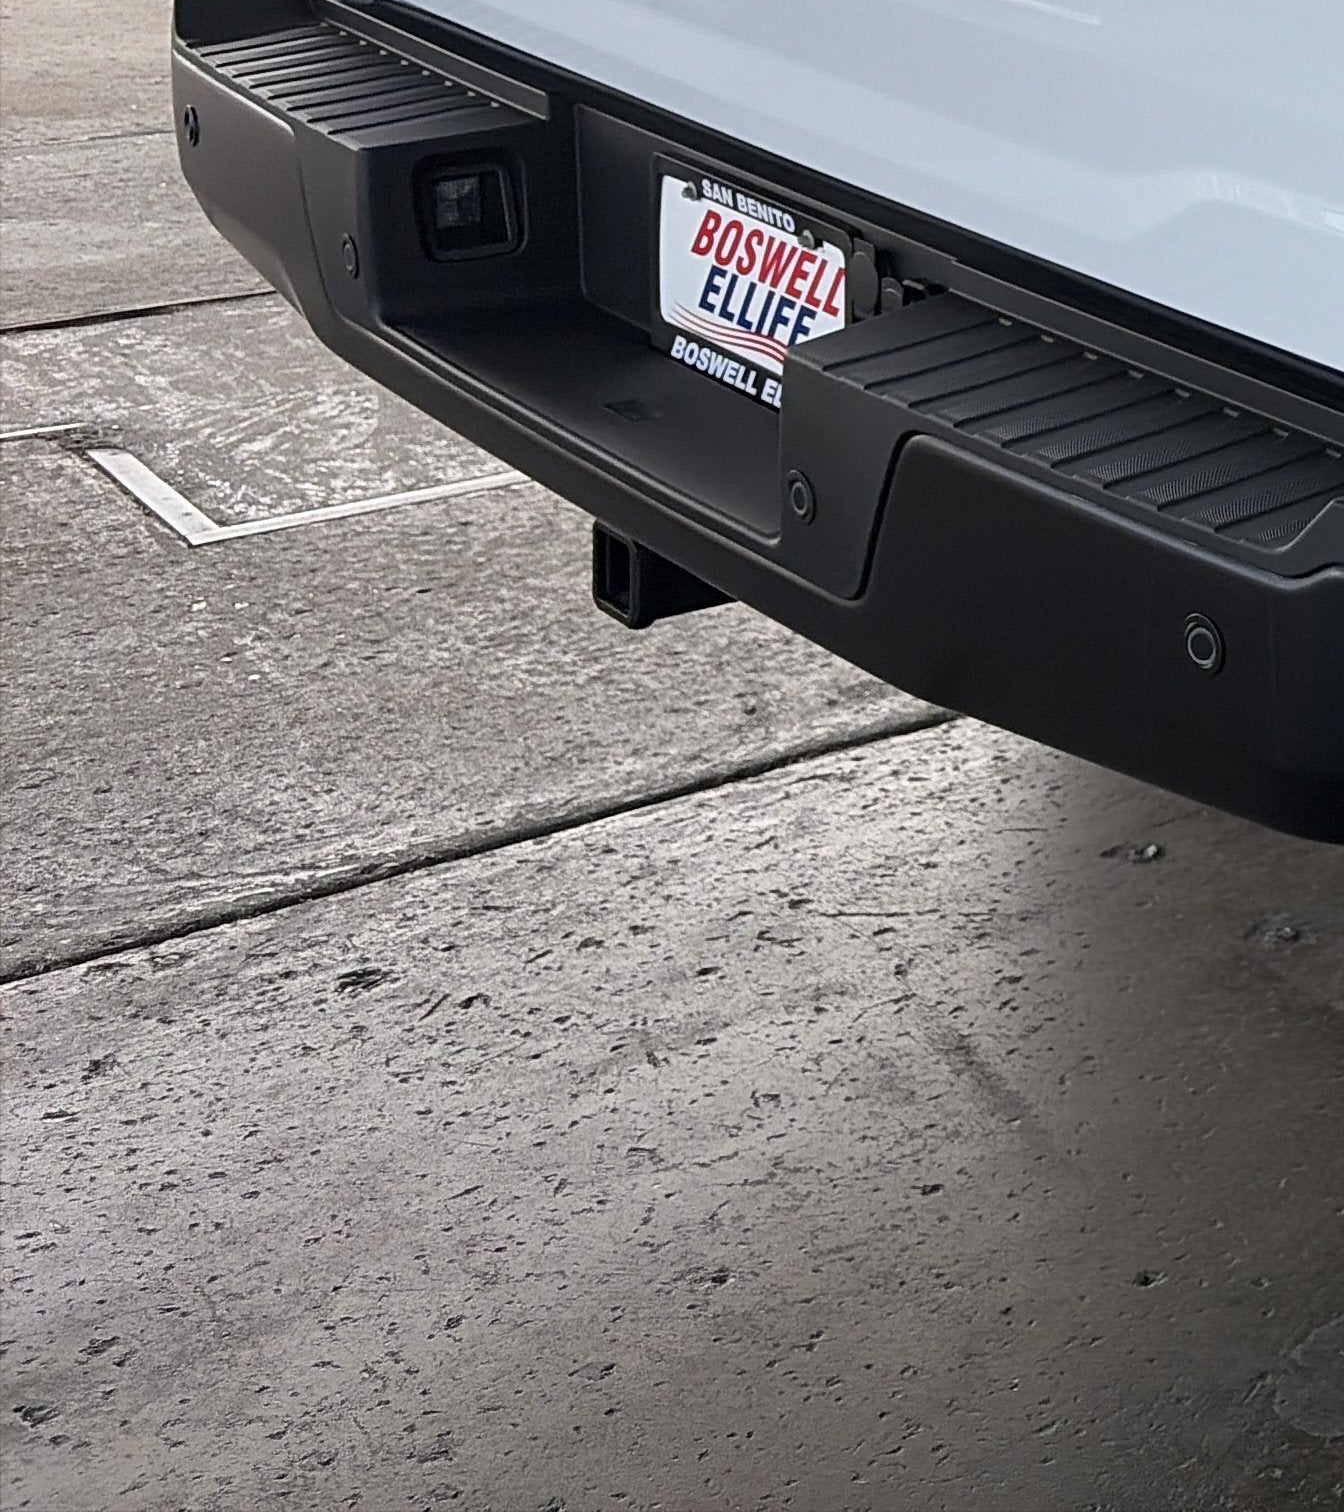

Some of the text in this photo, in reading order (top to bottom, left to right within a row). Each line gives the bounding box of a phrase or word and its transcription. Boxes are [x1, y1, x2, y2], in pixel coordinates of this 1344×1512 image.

[702, 179, 796, 233] SAN BENITO
[690, 209, 847, 318] BOSWELL
[699, 264, 817, 347] ELLIFF
[670, 335, 757, 396] BOSWELL
